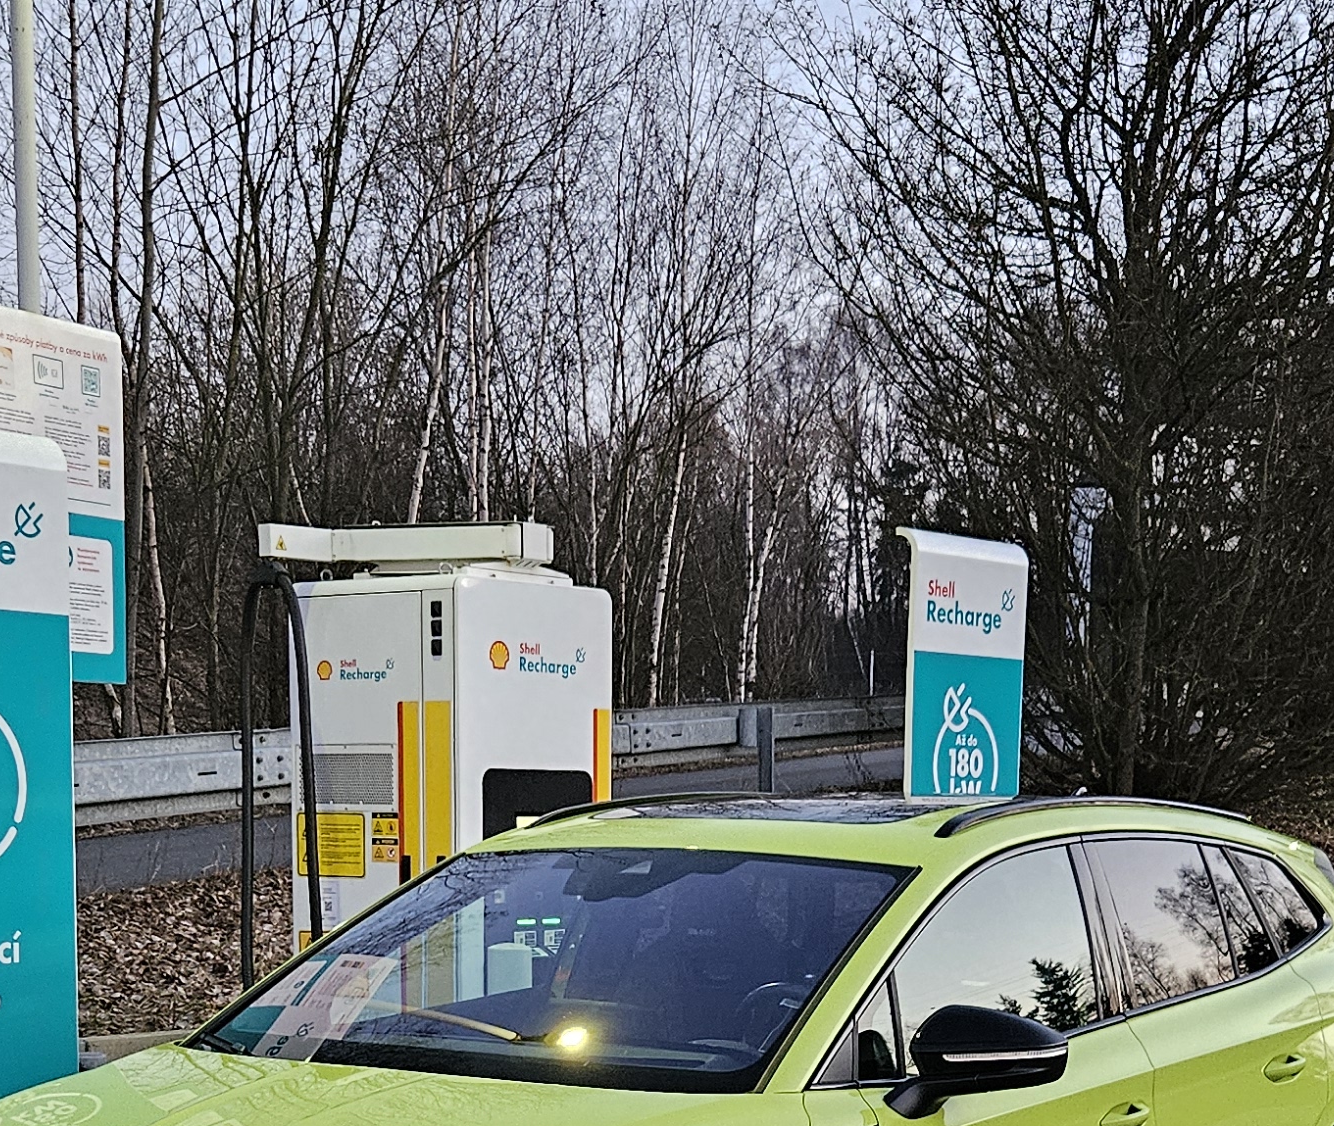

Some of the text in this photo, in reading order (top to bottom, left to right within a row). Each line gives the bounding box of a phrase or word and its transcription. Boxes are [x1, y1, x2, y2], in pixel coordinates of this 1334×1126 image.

[928, 579, 955, 598] Shell
[926, 600, 1002, 635] Recharge
[519, 642, 540, 655] Shell
[340, 659, 356, 668] Shell
[519, 656, 576, 679] Recharge
[340, 667, 387, 682] Recharge
[955, 733, 977, 747] Až do
[949, 748, 984, 778] 180
